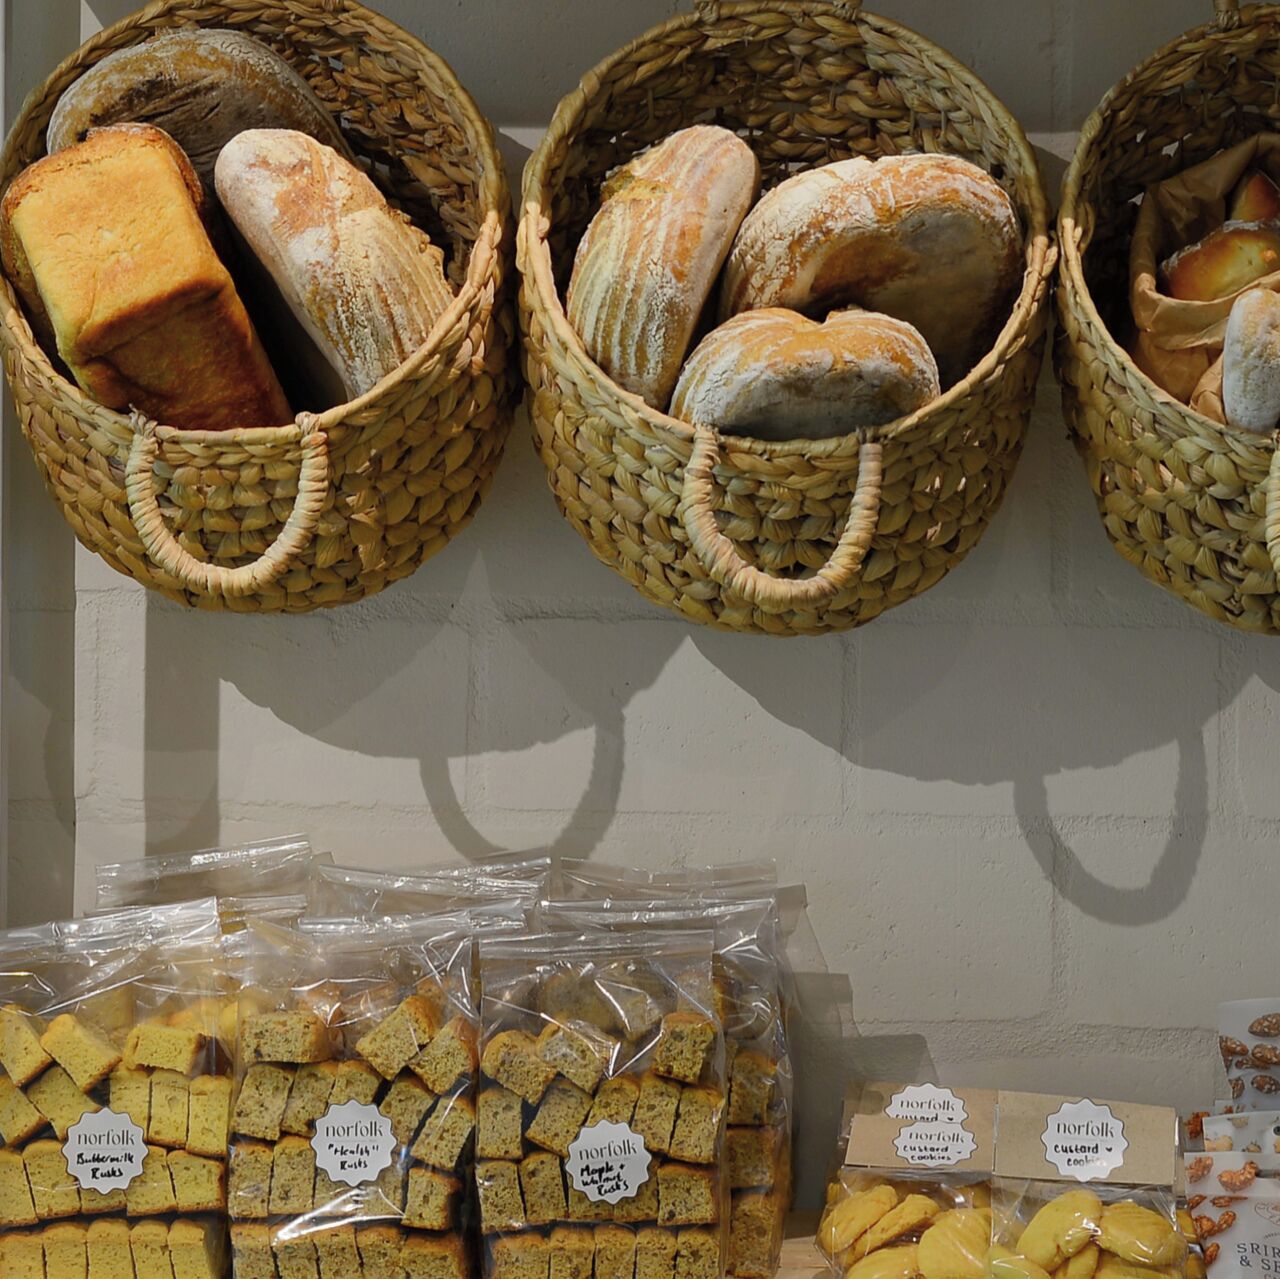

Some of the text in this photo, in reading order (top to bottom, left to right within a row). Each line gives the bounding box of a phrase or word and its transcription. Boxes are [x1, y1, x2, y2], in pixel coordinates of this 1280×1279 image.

[78, 1129, 135, 1145] norfolk
[326, 1121, 383, 1137] norfolk
[909, 1130, 965, 1144] norfolk
[1056, 1120, 1115, 1138] norfolk
[579, 1139, 637, 1160] norfolk
[1054, 1144, 1099, 1154] custard
[1240, 1256, 1252, 1267] &
